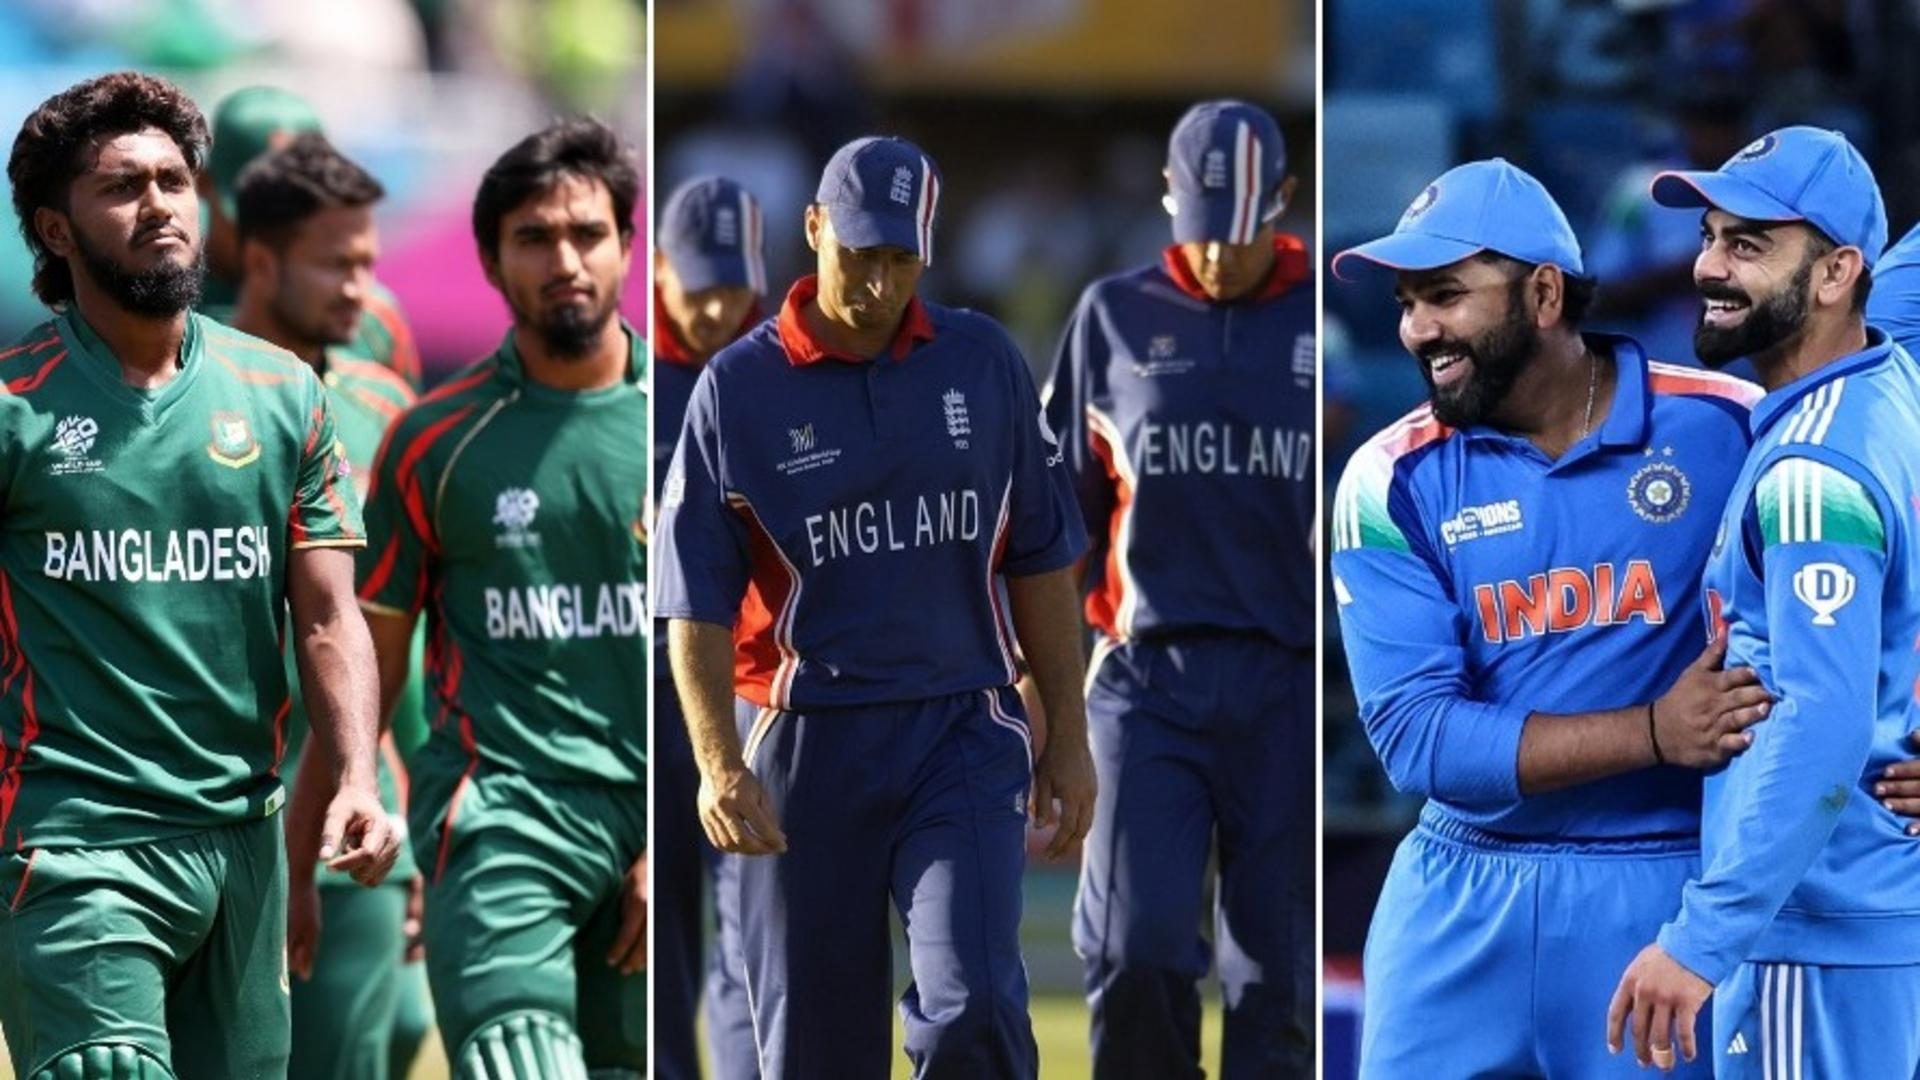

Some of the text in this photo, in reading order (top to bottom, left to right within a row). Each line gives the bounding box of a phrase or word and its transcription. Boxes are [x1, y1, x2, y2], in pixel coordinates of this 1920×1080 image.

[1144, 422, 1311, 482] ENGLAND
[44, 525, 272, 582] BANGLADESH
[805, 489, 979, 567] ENGLAND
[1474, 560, 1665, 643] INDIA
[1816, 569, 1836, 600] D
